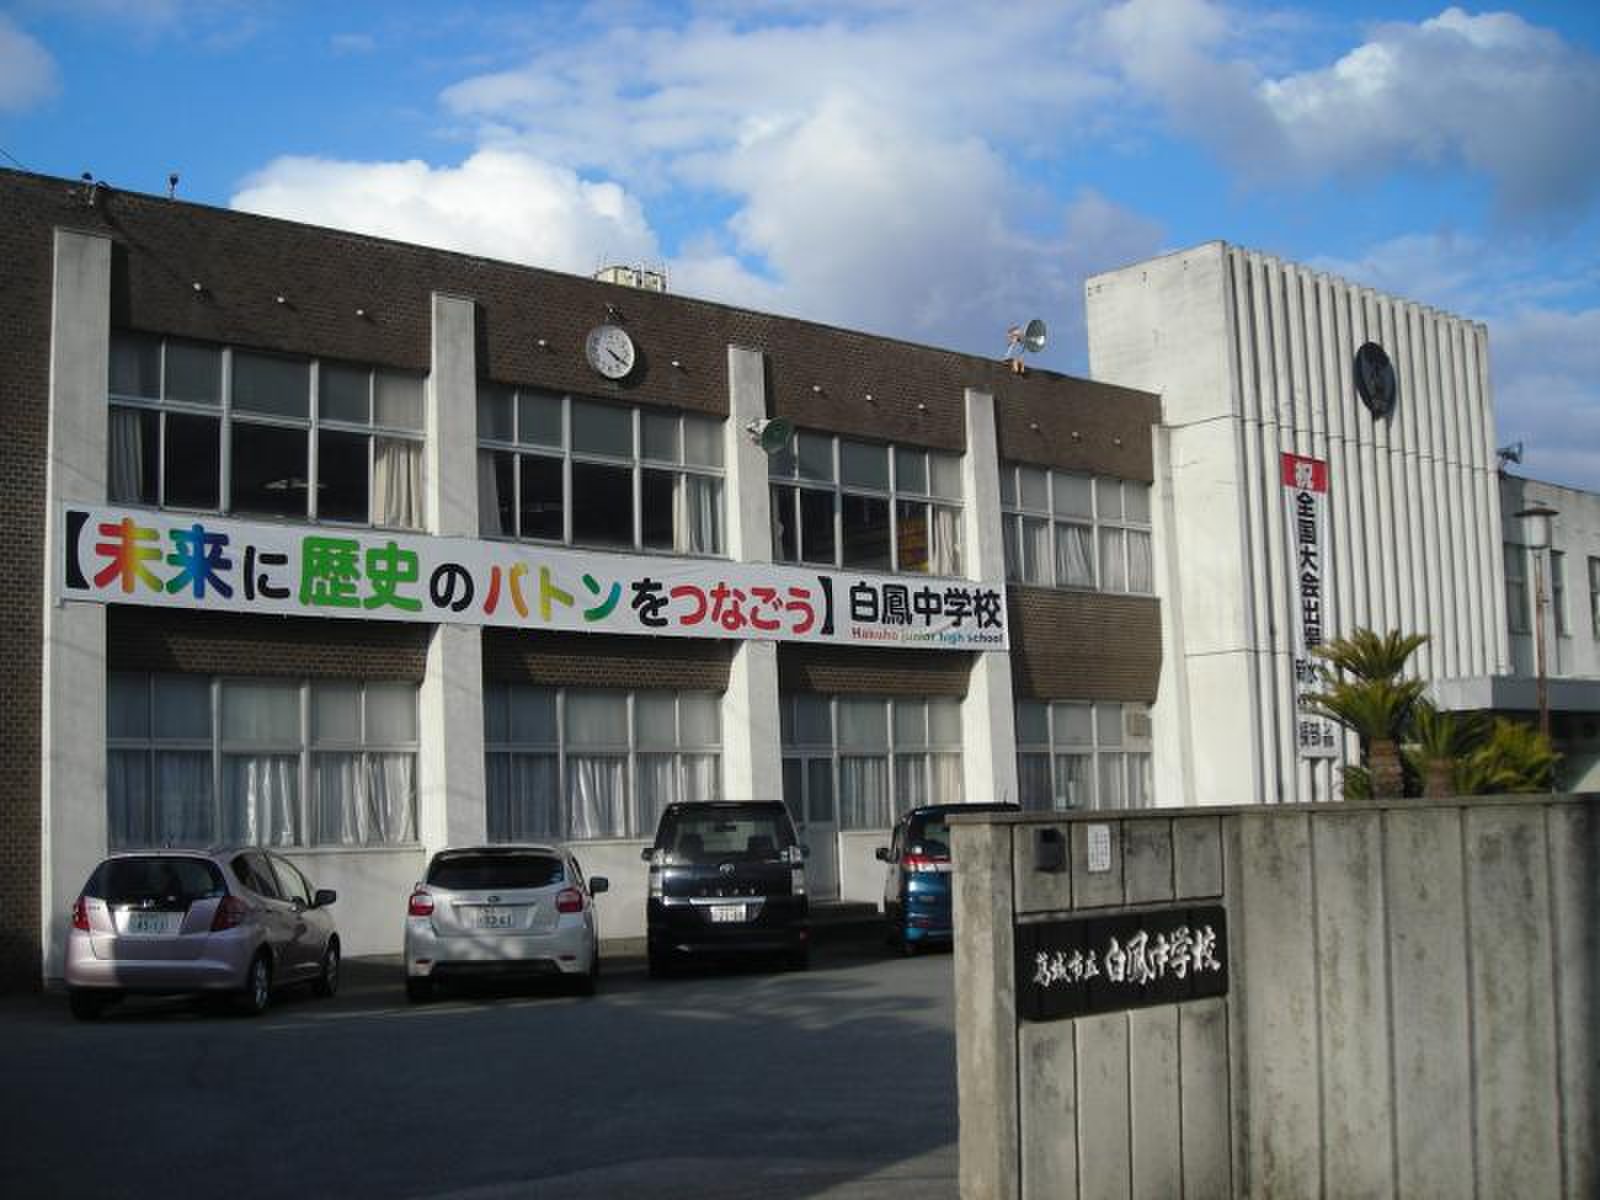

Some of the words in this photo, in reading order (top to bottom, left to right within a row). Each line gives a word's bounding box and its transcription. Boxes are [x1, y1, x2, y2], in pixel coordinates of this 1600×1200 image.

[849, 580, 1003, 628] 白鳳中学校
[967, 632, 1004, 643] school
